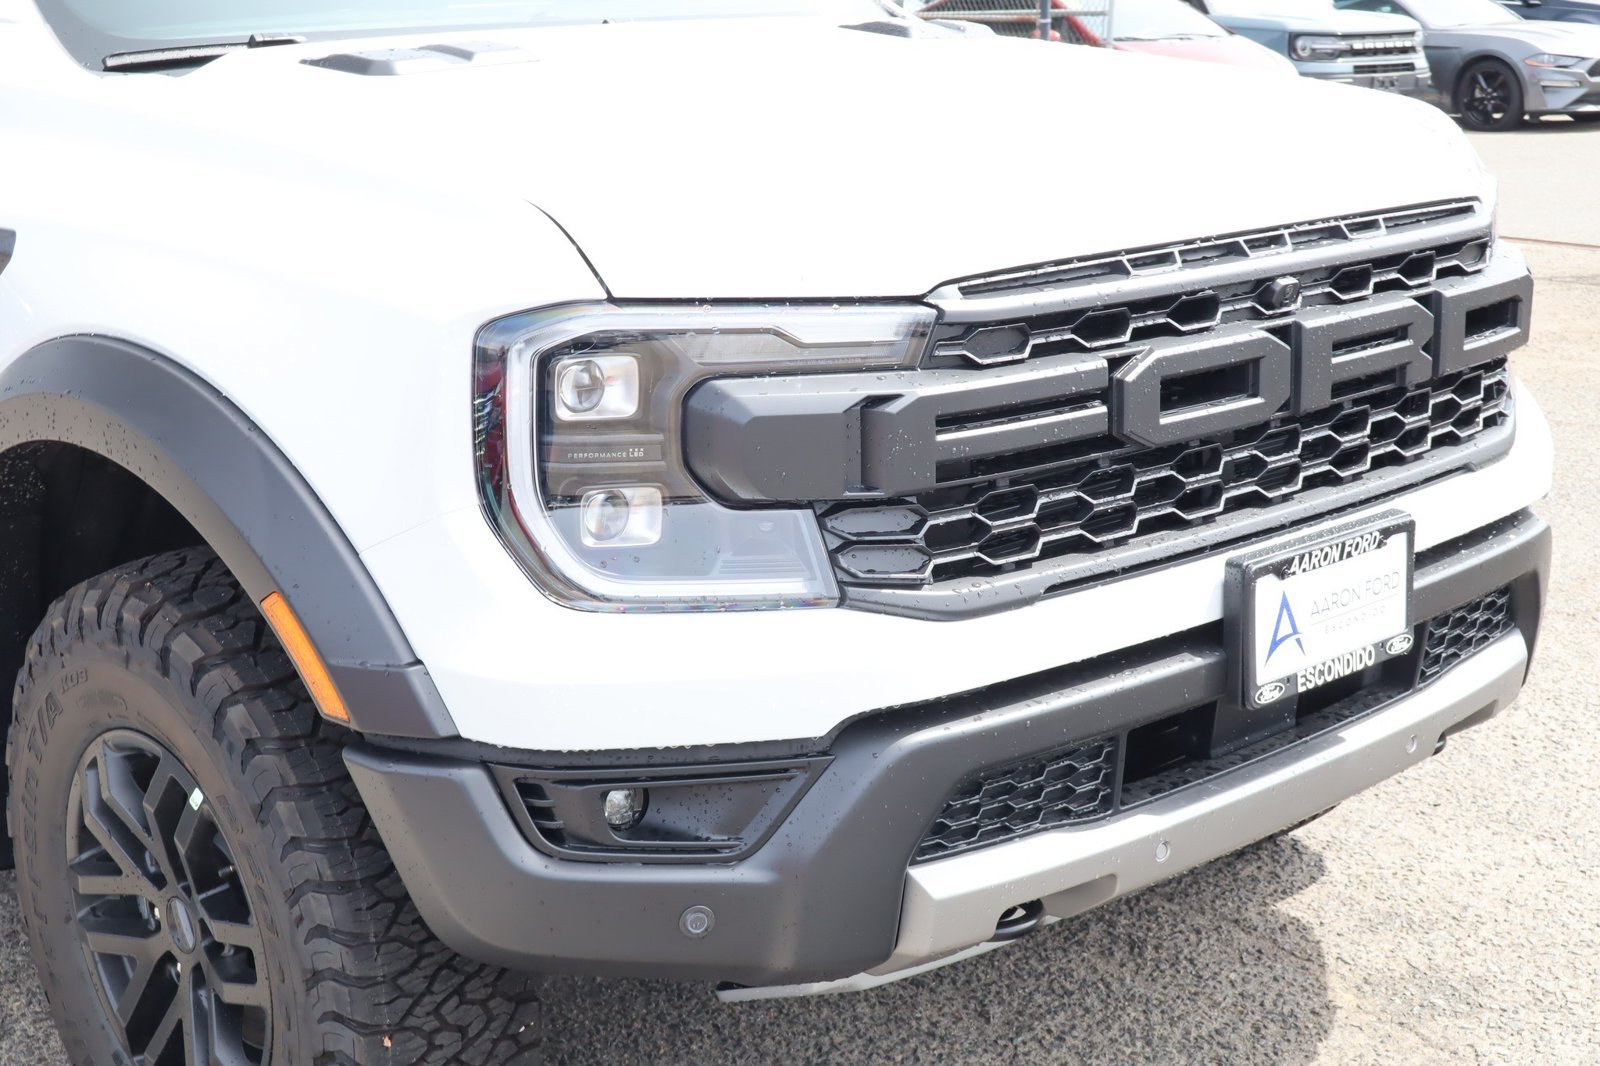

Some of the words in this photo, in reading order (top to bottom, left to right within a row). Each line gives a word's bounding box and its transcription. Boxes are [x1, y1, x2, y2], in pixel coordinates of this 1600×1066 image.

[862, 275, 1532, 498] FORD
[1289, 542, 1341, 575] AARON
[1343, 531, 1380, 560] FORD
[1311, 588, 1360, 617] AARON
[1366, 571, 1400, 596] FORD
[1297, 645, 1376, 693] ESCONDIDO
